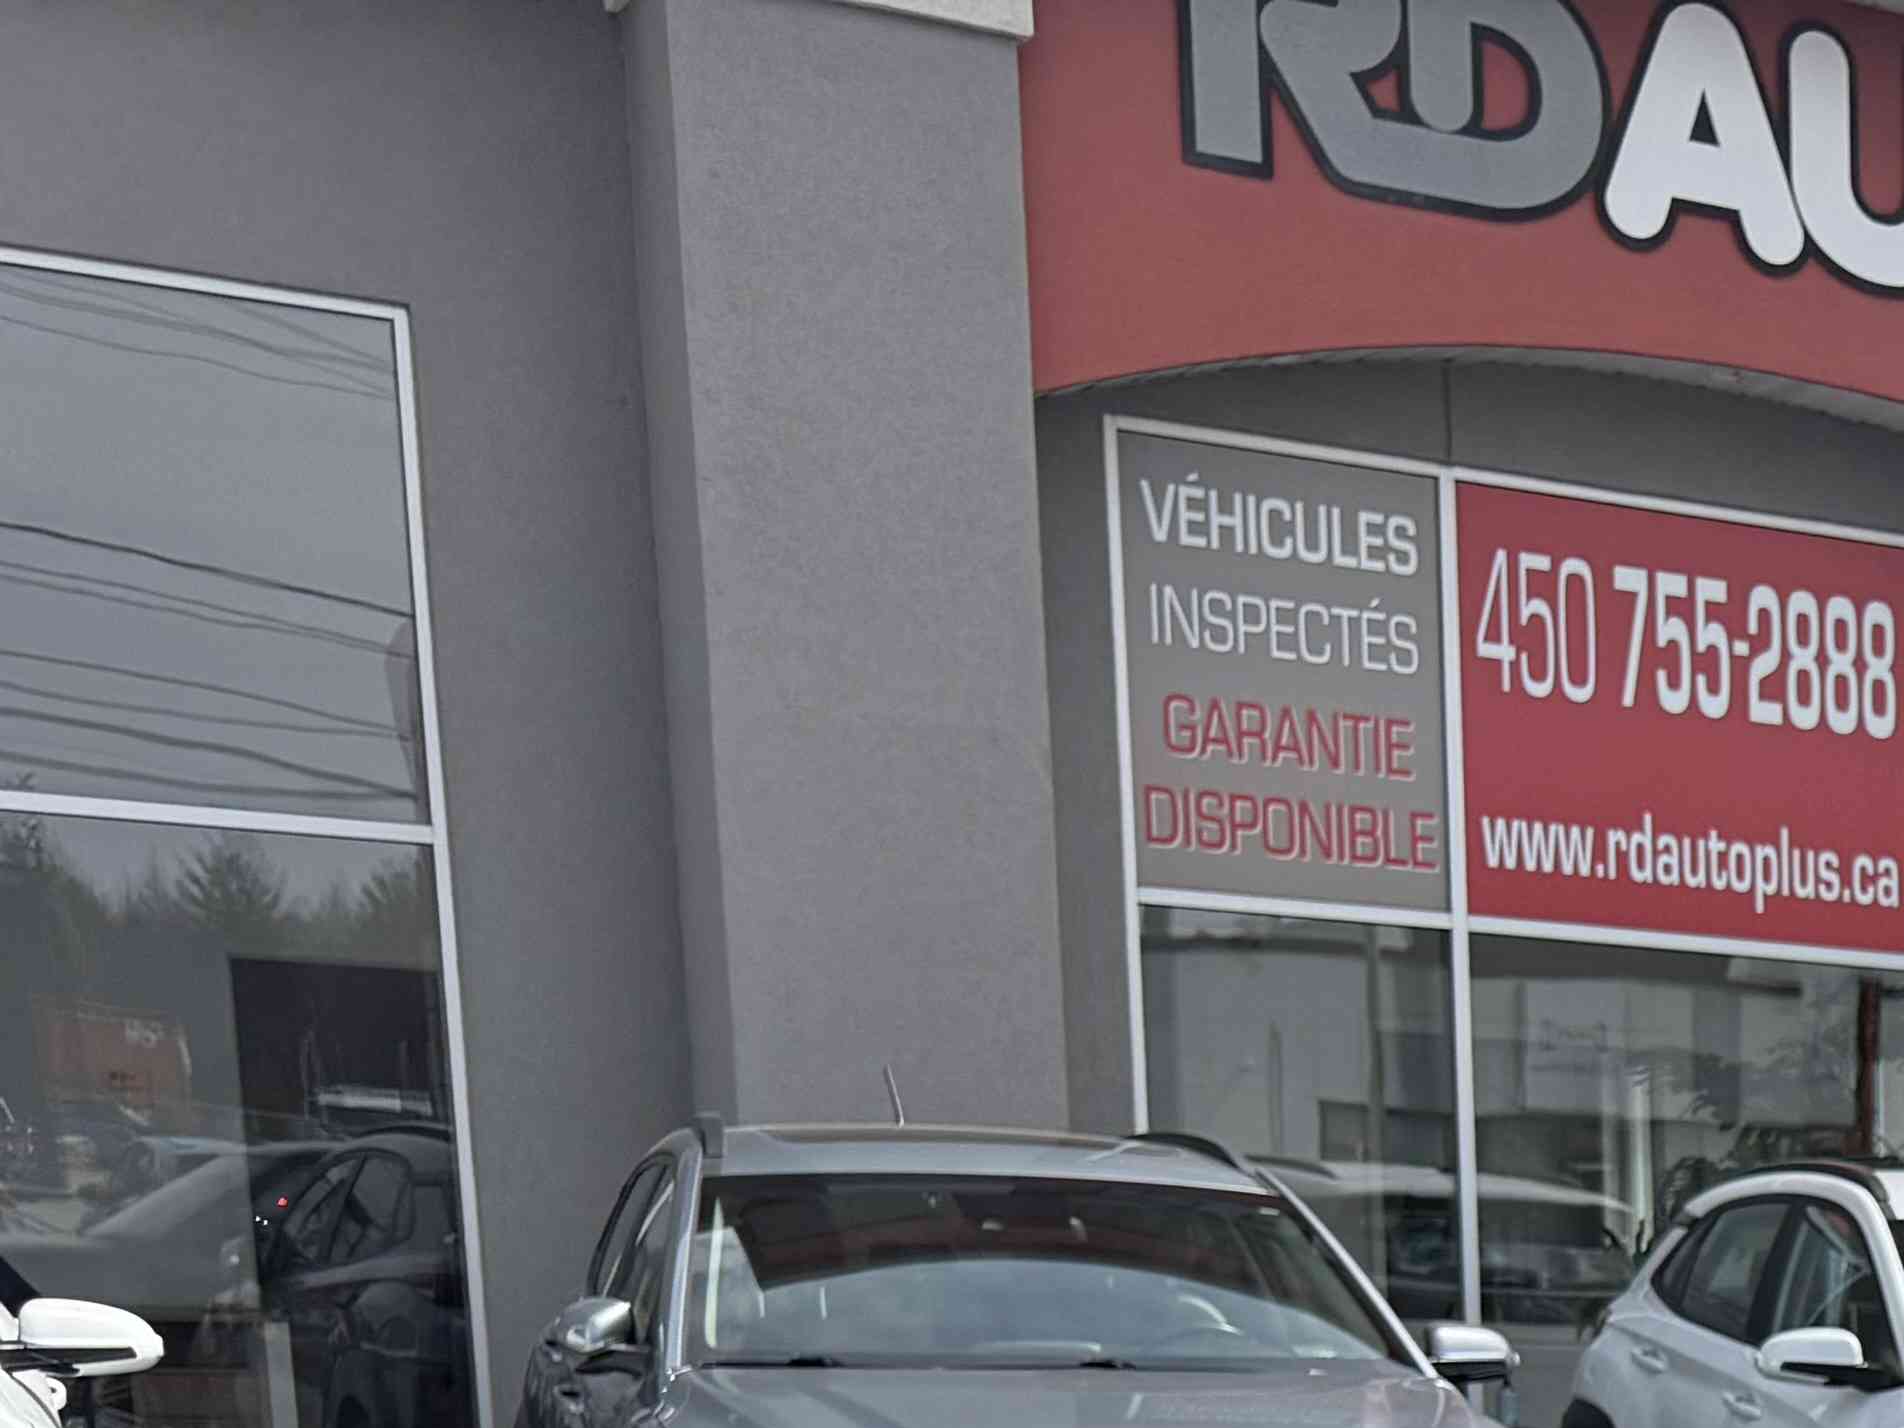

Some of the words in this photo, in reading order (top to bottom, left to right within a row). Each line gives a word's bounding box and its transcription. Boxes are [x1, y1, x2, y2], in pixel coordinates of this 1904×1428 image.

[1139, 472, 1419, 576] VÉHICULES
[1148, 581, 1420, 675] INSPECTÉS
[1475, 548, 1597, 704] 450
[1612, 564, 1898, 740] 755-2888
[1161, 692, 1417, 782] GARANTIE
[1143, 783, 1440, 873] DISPONIBLE
[1480, 811, 1900, 914] www.rdautoplus.ca
